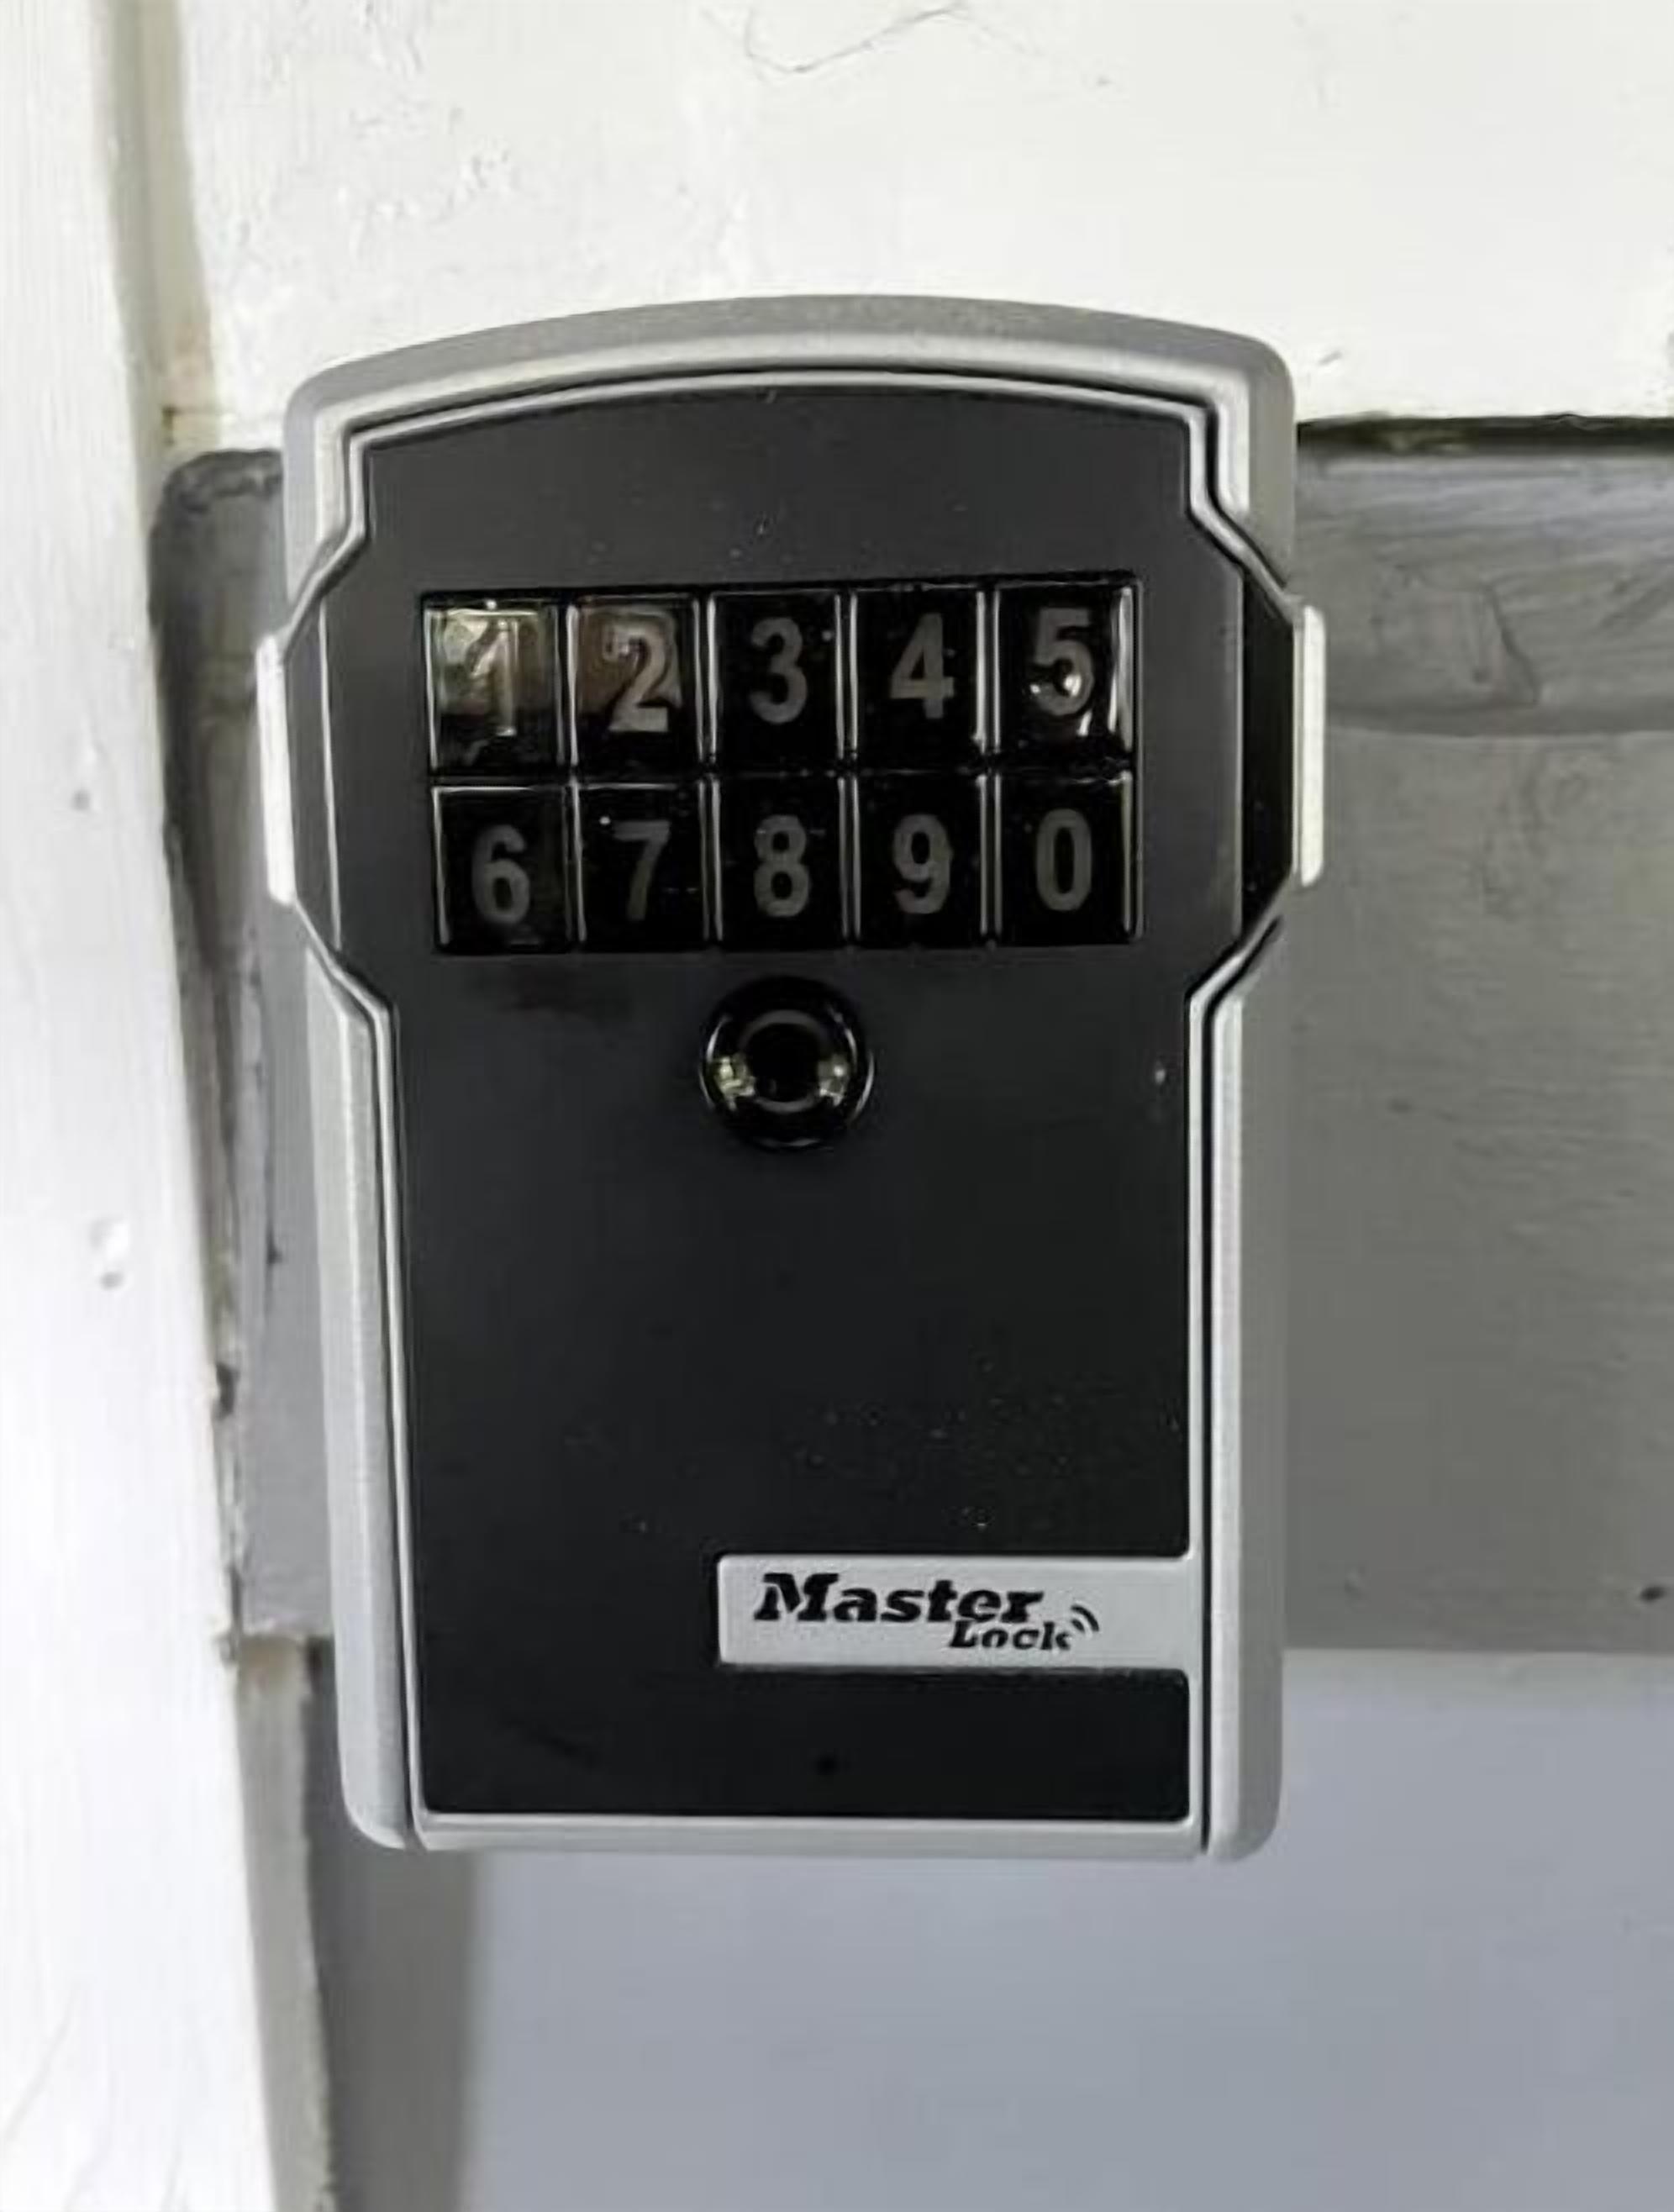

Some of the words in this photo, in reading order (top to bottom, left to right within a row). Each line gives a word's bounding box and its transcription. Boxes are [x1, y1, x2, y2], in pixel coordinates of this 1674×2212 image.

[471, 620, 517, 736] 1
[603, 617, 671, 733] 2
[749, 617, 808, 724] 3
[891, 613, 955, 719] 4
[1034, 608, 1094, 716] 5
[471, 825, 530, 924] 6
[613, 820, 670, 921] 7
[753, 814, 812, 917] 8
[893, 814, 951, 914] 9
[1034, 808, 1092, 913] 0
[754, 1572, 1045, 1623] Master
[948, 1620, 1073, 1651] Lock
